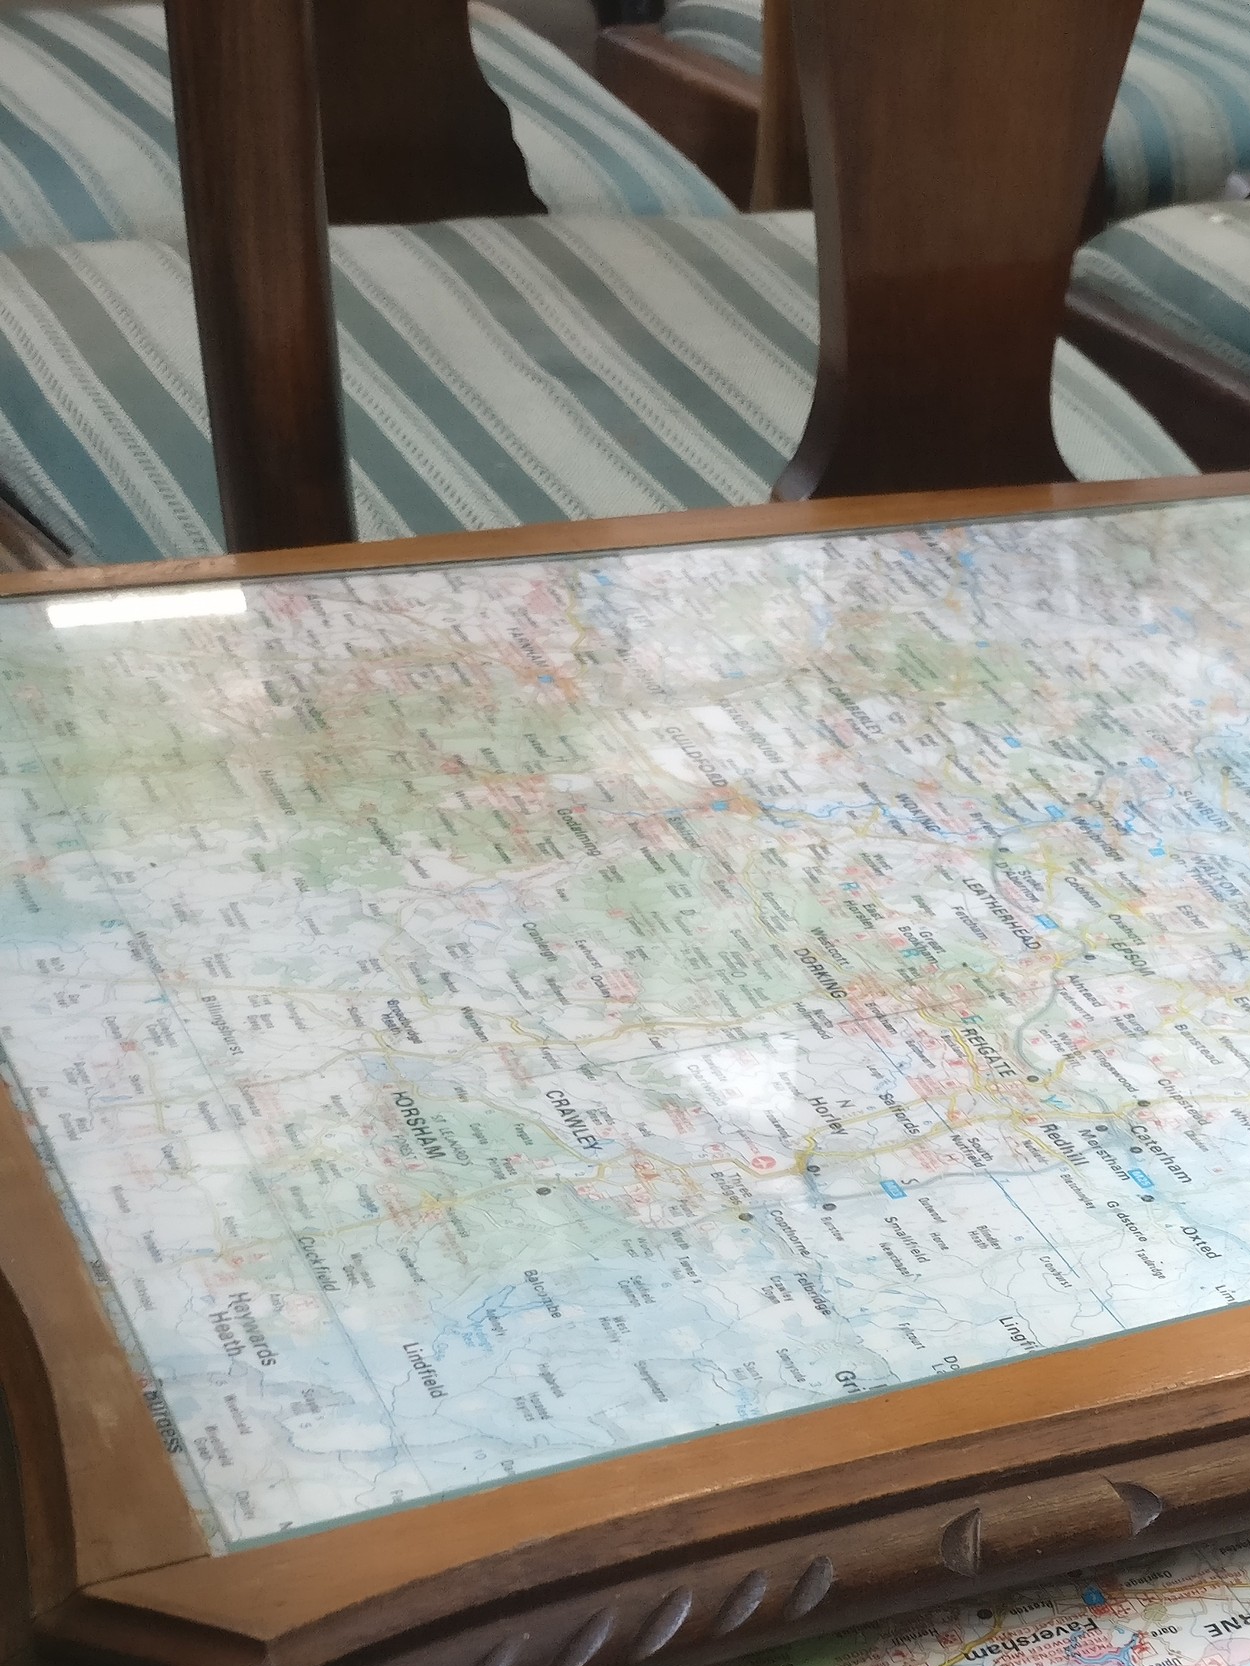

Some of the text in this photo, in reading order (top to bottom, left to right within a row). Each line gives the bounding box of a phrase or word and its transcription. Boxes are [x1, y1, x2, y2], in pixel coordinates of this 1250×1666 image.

[861, 903, 886, 920] East
[1062, 876, 1104, 908] Cobham
[840, 900, 878, 930] Horsley
[949, 906, 991, 940] Fetcham
[961, 877, 1043, 950] LEATHERHEAD
[1175, 904, 1212, 929] Esher
[808, 927, 852, 965] Westcott
[895, 925, 941, 964] Bookham
[917, 930, 948, 954] Great
[792, 948, 848, 999] DORKING
[196, 995, 248, 1056] Billingshurst
[1053, 987, 1097, 1022] Tadworth
[1053, 1032, 1089, 1060] Walton
[1108, 1016, 1139, 1039] Heath
[1172, 1024, 1223, 1065] Banstead
[958, 1028, 1017, 1078] REIGATE
[1087, 1049, 1139, 1093] Kingswood
[542, 1089, 602, 1152] CRAWLEY
[803, 1096, 852, 1137] Horley
[1153, 1078, 1212, 1126] Chipstead
[964, 1137, 996, 1162] South
[1038, 1123, 1089, 1166] Redhill
[1074, 1129, 1133, 1181] Merstham
[1126, 1124, 1196, 1184] Caterham
[707, 1171, 746, 1206] Bridges
[725, 1173, 755, 1198] Three
[765, 1209, 814, 1257] Copthorne
[882, 1216, 931, 1263] Smallfield
[1179, 1226, 1221, 1259] Oxted
[294, 1235, 342, 1293] Cuckfield
[520, 1269, 567, 1319] Balcombe
[205, 1310, 248, 1357] Heath
[223, 1291, 284, 1368] Haywards
[400, 1341, 449, 1399] Lindfield
[962, 1616, 1096, 1664] Faversham
[1149, 1624, 1177, 1638] Oare
